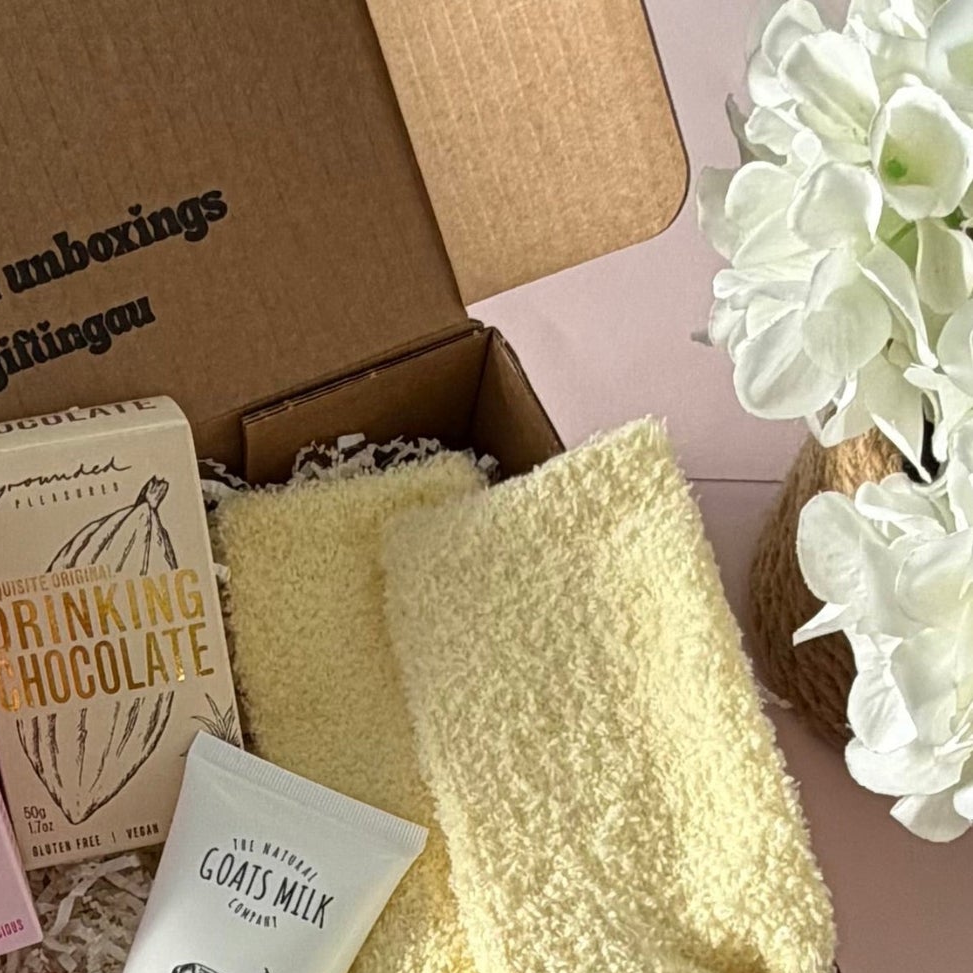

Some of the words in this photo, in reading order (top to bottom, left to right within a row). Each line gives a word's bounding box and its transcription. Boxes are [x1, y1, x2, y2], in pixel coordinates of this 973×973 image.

[2, 190, 228, 294] unboxings
[24, 806, 47, 820] 50g
[32, 841, 72, 858] GLUTEN
[76, 834, 102, 850] FREE
[126, 823, 159, 839] VEGAN
[199, 847, 274, 901] GOATS
[272, 877, 334, 930] MILK
[228, 898, 278, 929] COMPANY
